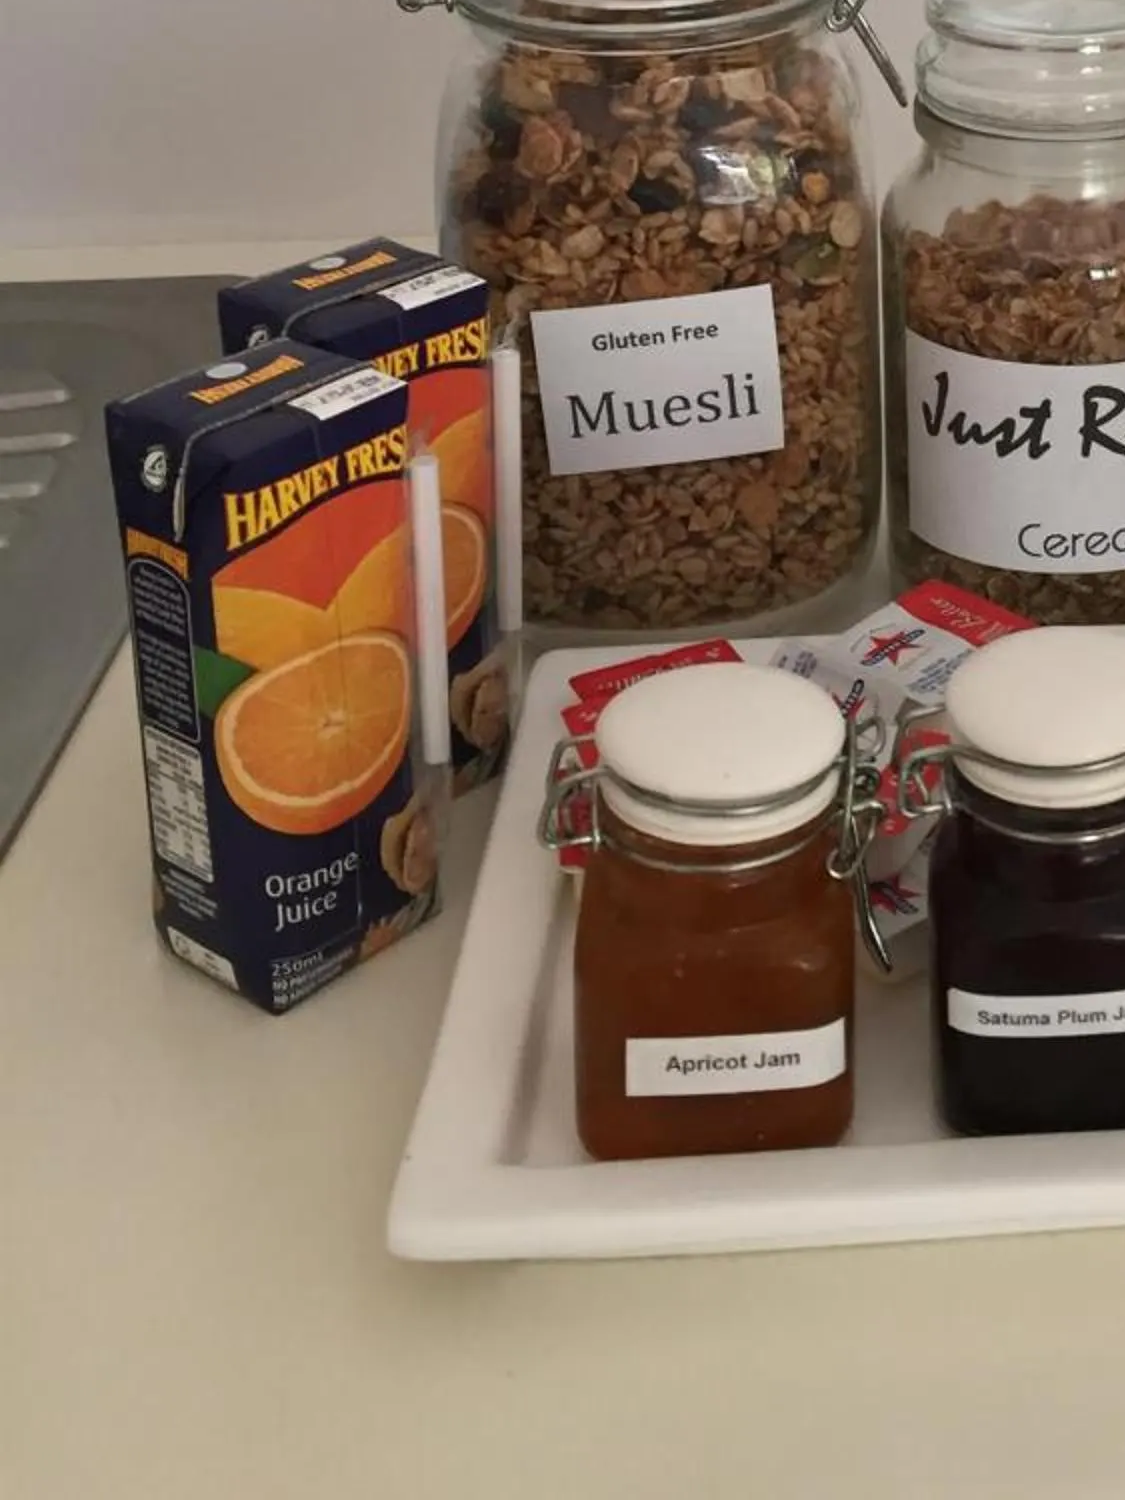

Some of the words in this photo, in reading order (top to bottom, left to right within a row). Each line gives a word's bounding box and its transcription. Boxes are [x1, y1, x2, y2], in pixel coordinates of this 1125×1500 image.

[591, 327, 665, 352] Gluten
[671, 321, 719, 344] Free
[565, 373, 760, 439] Muesli
[922, 370, 1052, 460] Just
[224, 456, 339, 551] HARVEY
[265, 851, 359, 898] Orange
[274, 891, 337, 933] Juice
[977, 1010, 1051, 1026] Satuma
[1056, 1009, 1108, 1025] Plum
[665, 1054, 749, 1075] Apricot
[754, 1052, 801, 1069] Jam
